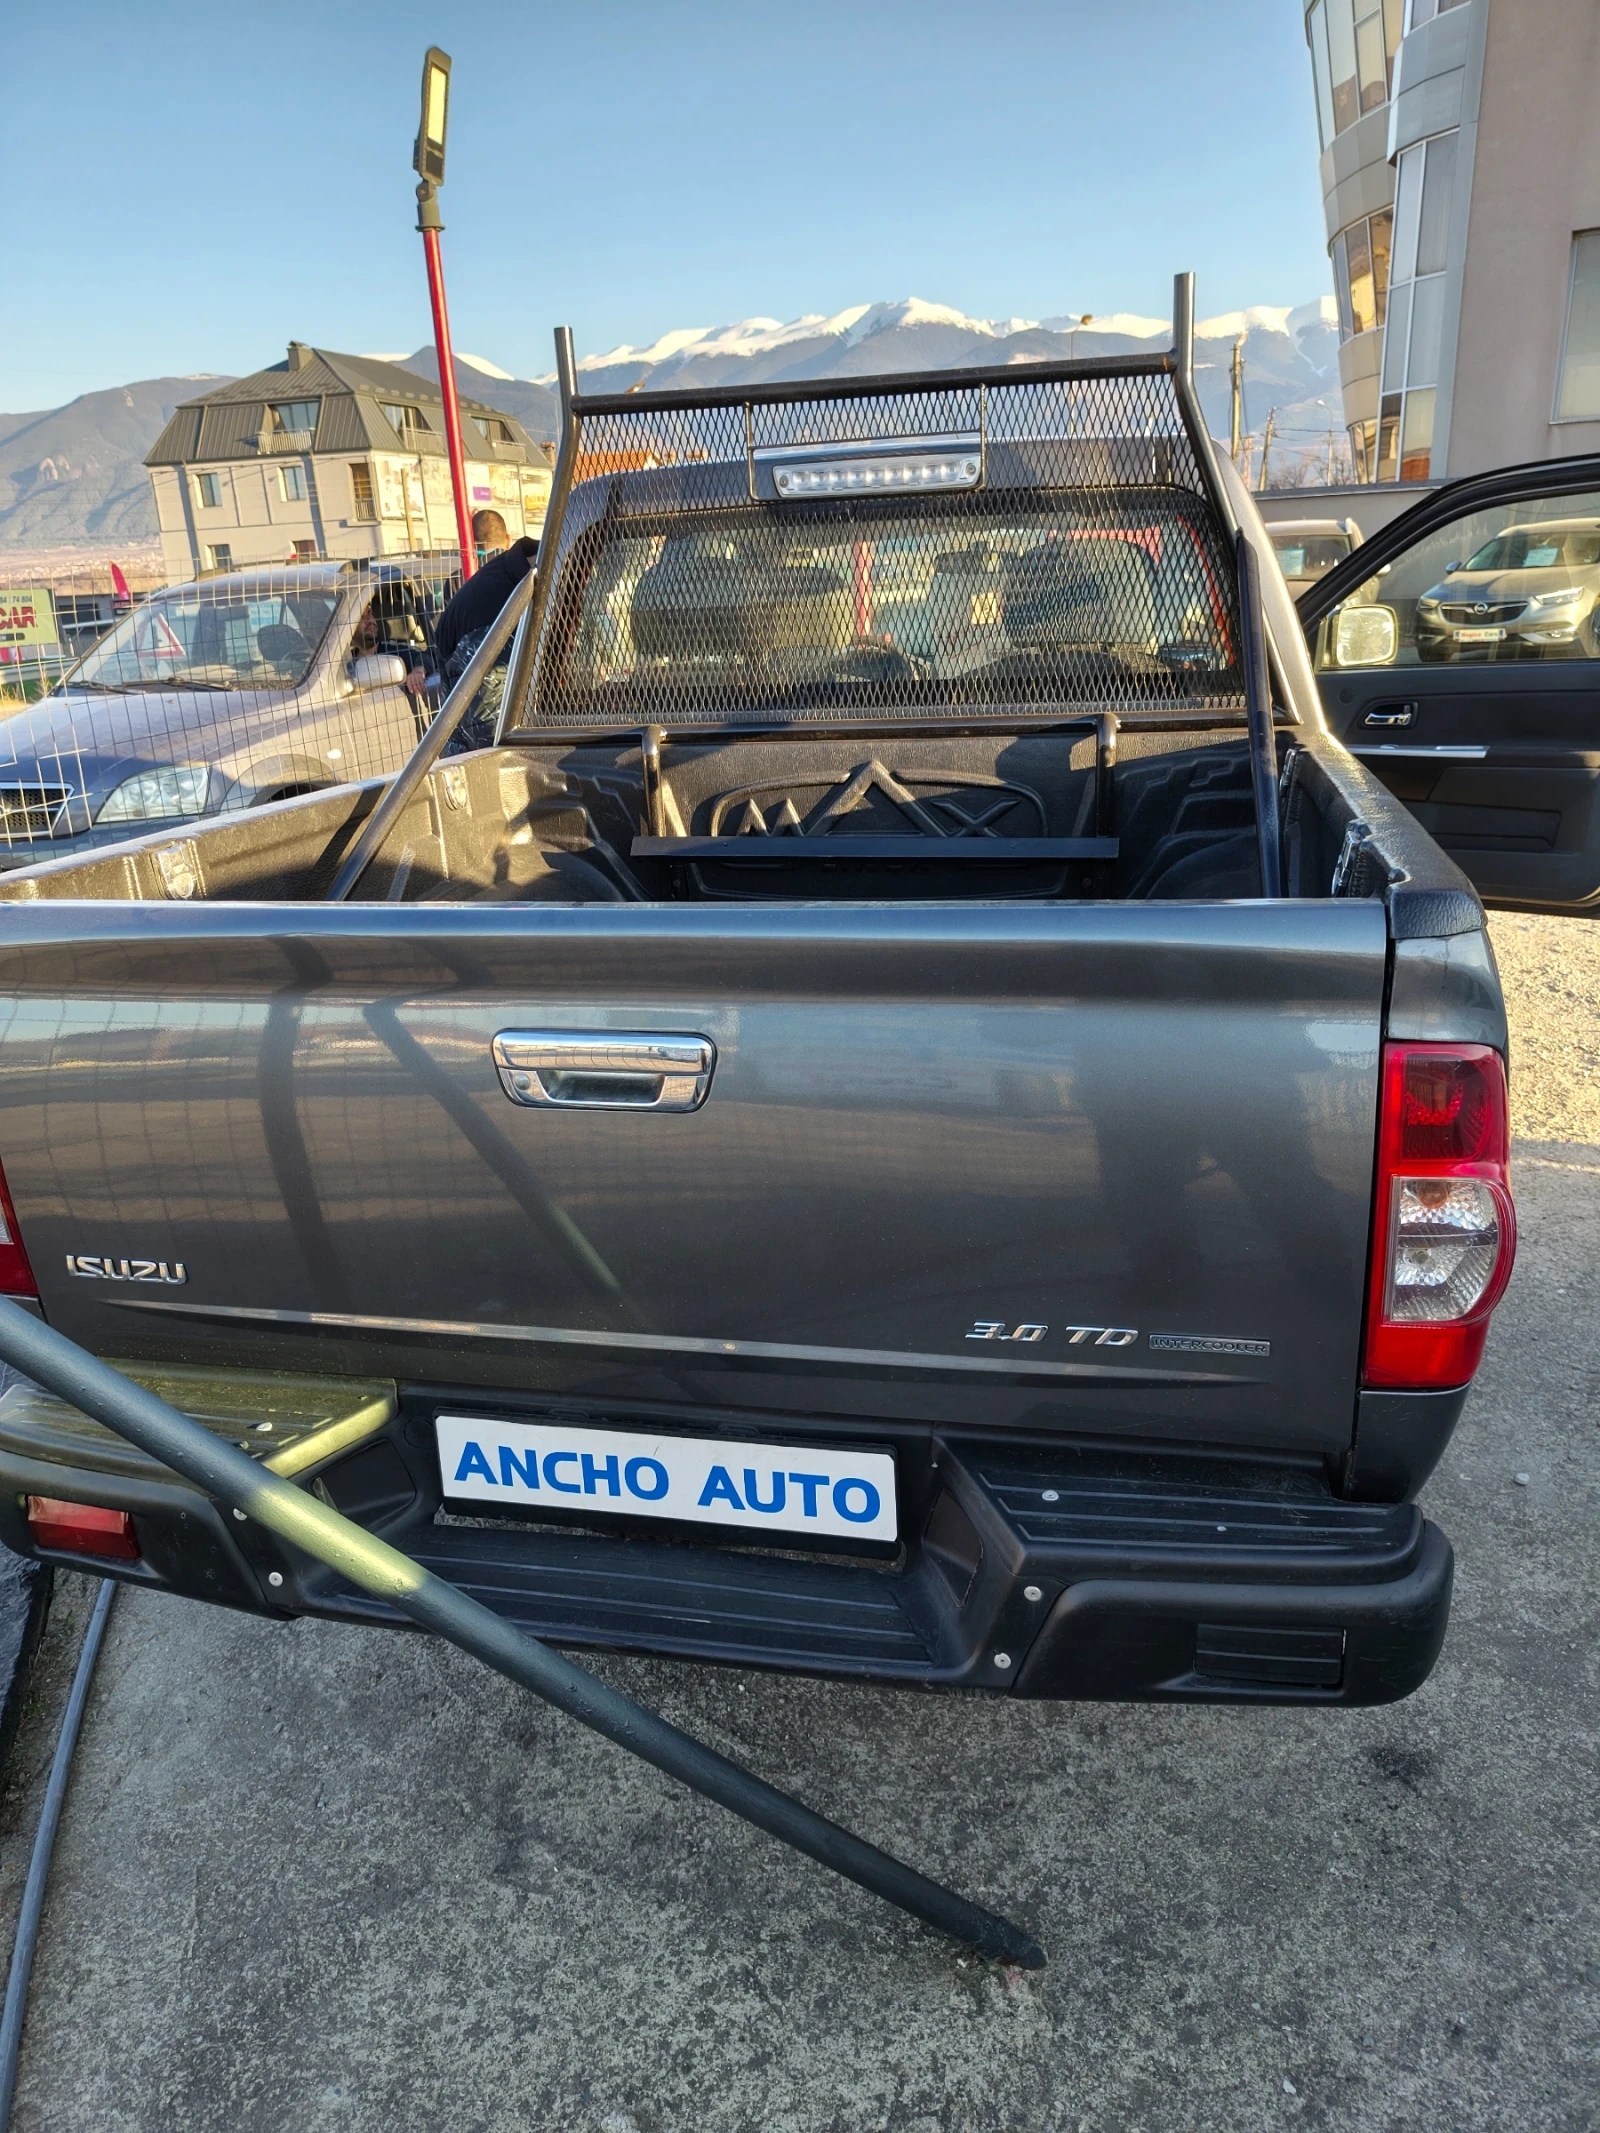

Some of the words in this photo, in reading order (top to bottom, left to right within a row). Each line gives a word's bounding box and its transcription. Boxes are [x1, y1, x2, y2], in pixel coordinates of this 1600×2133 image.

[66, 1254, 188, 1285] ISUZU
[965, 1320, 1049, 1342] 3.0
[1065, 1324, 1138, 1346] TD
[1153, 1338, 1267, 1355] INTERCOOLER
[454, 1441, 670, 1501] ANCHO
[697, 1465, 881, 1523] AUTO
